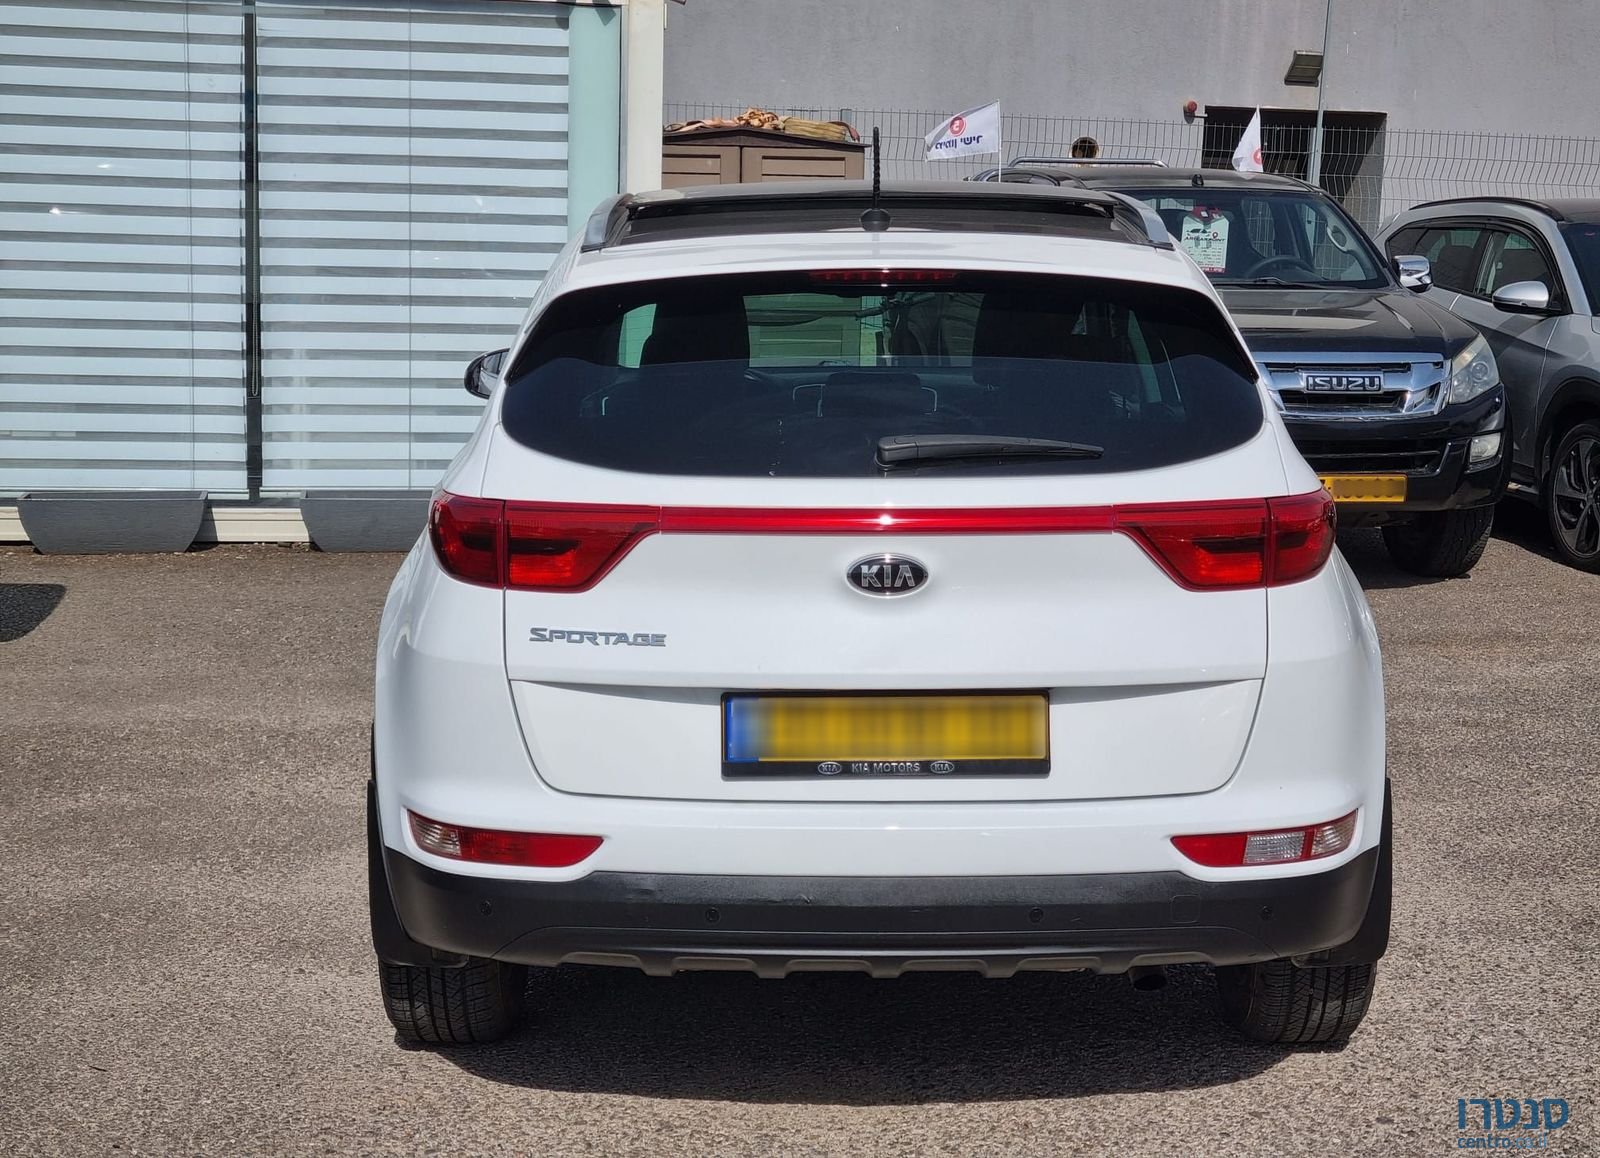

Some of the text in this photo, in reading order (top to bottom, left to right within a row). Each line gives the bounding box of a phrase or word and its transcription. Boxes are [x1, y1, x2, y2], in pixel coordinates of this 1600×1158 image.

[1307, 376, 1380, 391] ISUZU
[860, 564, 916, 588] KIA
[529, 627, 667, 647] SPORTAGE
[851, 762, 921, 773] KIA MOTORS
